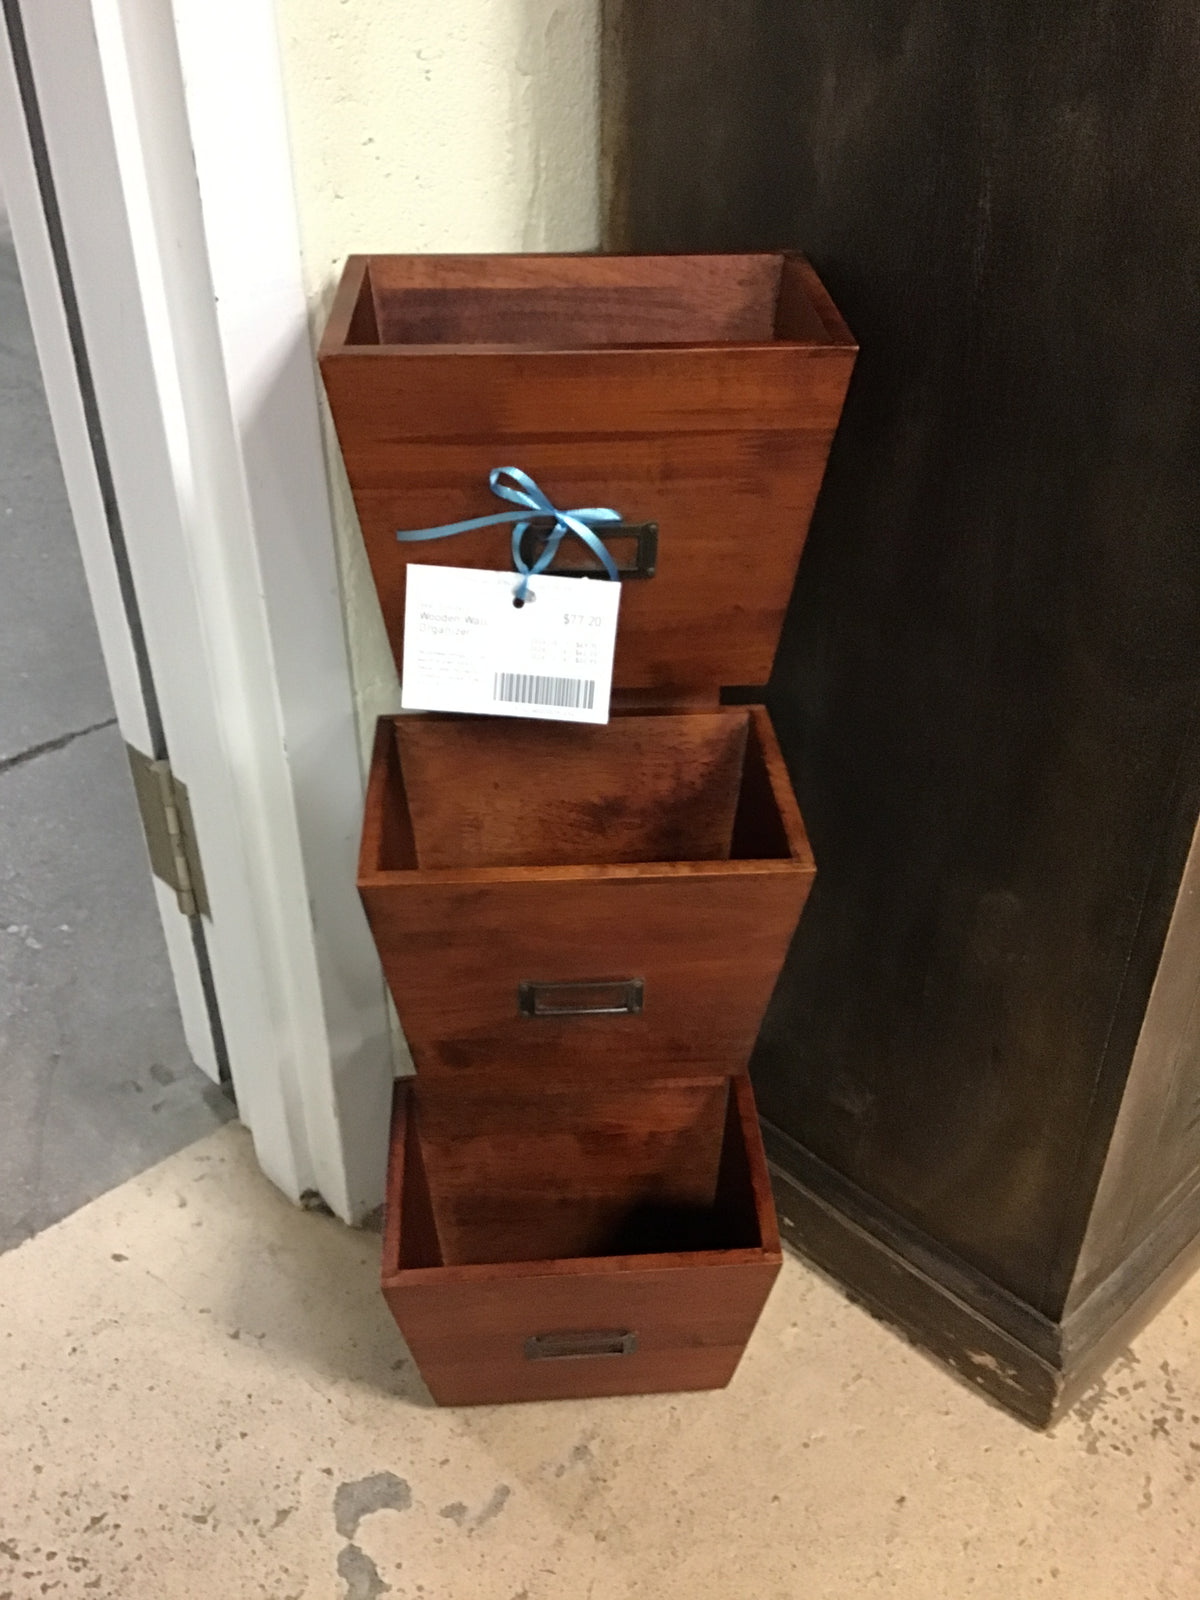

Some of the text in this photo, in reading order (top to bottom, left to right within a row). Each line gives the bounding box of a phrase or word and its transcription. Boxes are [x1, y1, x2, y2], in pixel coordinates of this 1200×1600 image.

[420, 611, 460, 623] Wooden
[563, 613, 602, 627] $7720
[419, 622, 470, 636] Organzer
